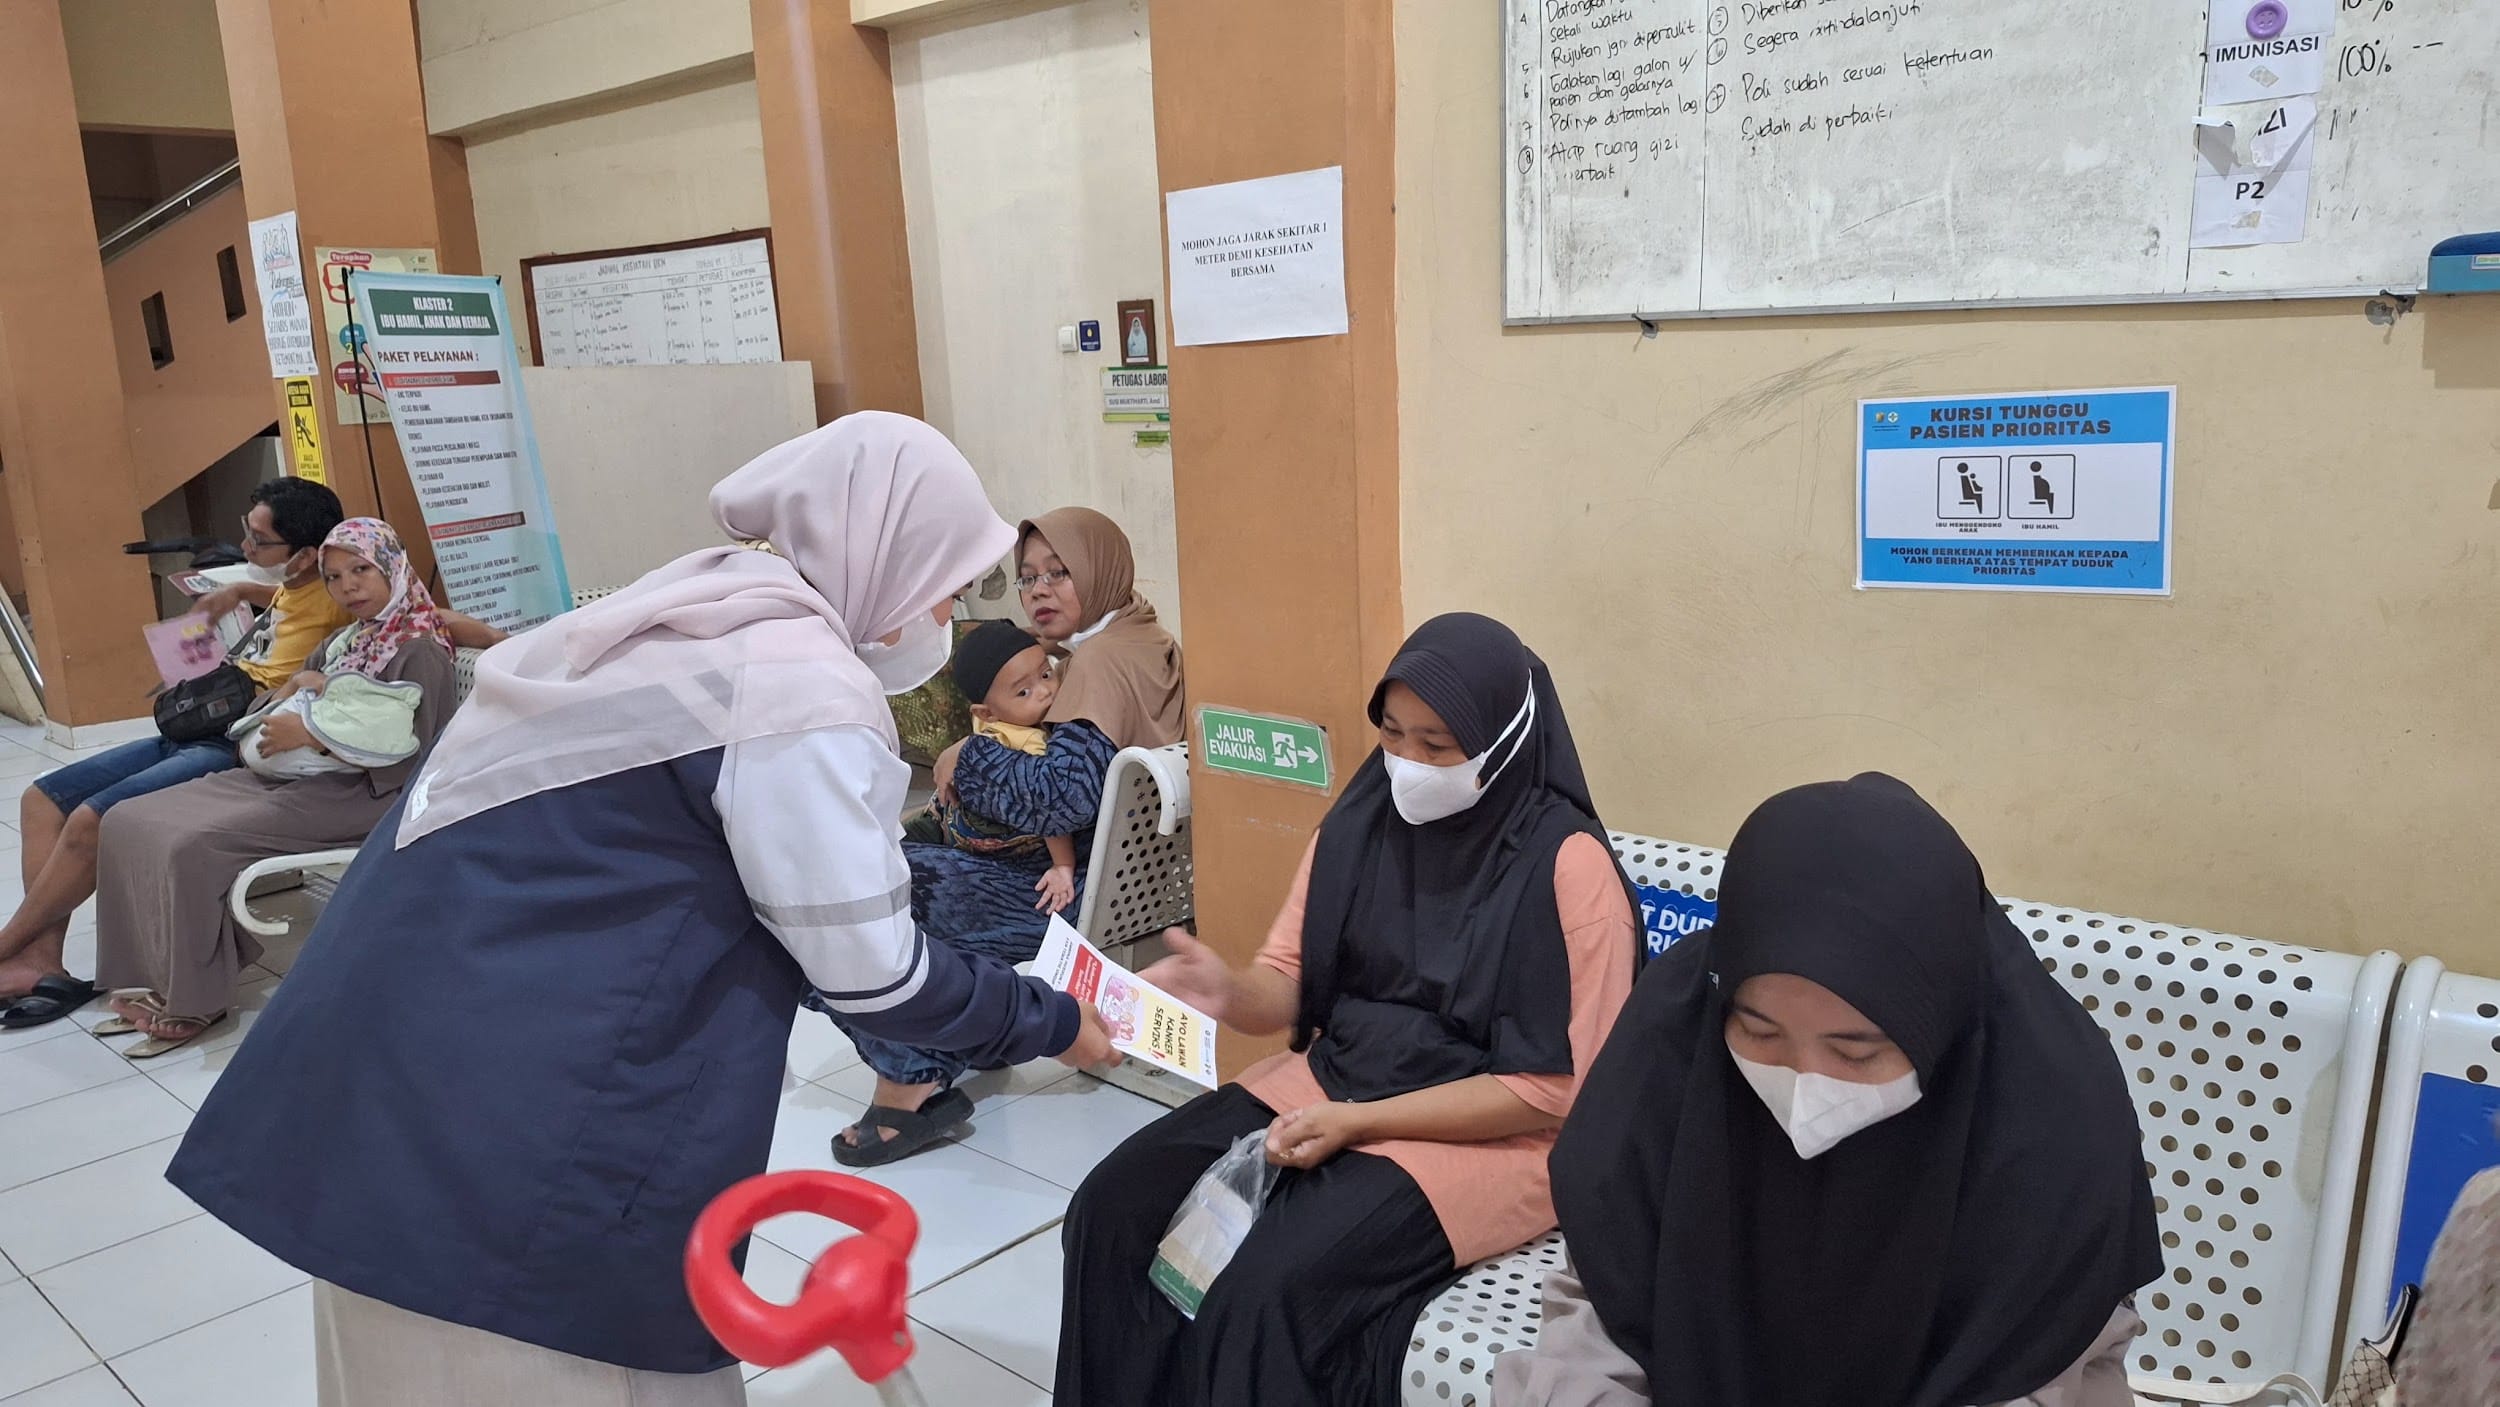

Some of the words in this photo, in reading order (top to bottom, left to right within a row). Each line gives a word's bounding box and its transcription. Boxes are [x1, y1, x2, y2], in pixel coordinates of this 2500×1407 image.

[1591, 10, 1633, 29] waktu
[1744, 30, 1799, 54] Segera
[2215, 36, 2320, 63] IMUNISASI
[1551, 44, 1601, 69] Rujukan
[1607, 41, 1627, 59] jgn
[1602, 69, 1626, 87] lagi
[1633, 59, 1670, 79] galon
[1784, 71, 1829, 95] sudah
[1843, 63, 1887, 83] sesuai
[1550, 93, 1581, 112] pasien
[1588, 85, 1614, 102] dan
[1620, 79, 1674, 101] gelasnya
[1604, 102, 1670, 125] ditambah
[1741, 115, 1792, 141] Sudah
[1799, 114, 1816, 132] di
[1549, 141, 1584, 164] Atap
[1595, 139, 1638, 162] ruang
[1650, 135, 1678, 160] gizi
[2236, 181, 2265, 200] P2
[1182, 237, 1215, 252] MOHON
[1216, 234, 1241, 247] JAGA
[1243, 229, 1275, 243] JARAK
[1277, 223, 1320, 238] SEKITAR
[1195, 250, 1226, 266] METER
[1228, 249, 1252, 262] DEMI
[1255, 241, 1314, 259] KESEHATAN
[1231, 263, 1275, 278] BERSAMA
[413, 297, 447, 311] KLASTER
[447, 299, 454, 311] 2
[380, 314, 396, 329] IBU
[424, 315, 446, 329] ANAK
[446, 315, 462, 329] DAN
[463, 315, 491, 329] REMAJA
[378, 351, 410, 363] PAKET
[414, 352, 473, 363] PELAYANAN
[1112, 374, 1143, 387] PETUGAS
[1931, 406, 1992, 422] KURSI
[1999, 403, 2089, 420] TUNGGU
[1910, 423, 1985, 439] PASIEN
[1992, 420, 2111, 438] PRIORITAS
[1891, 547, 1929, 557] MOHON
[1931, 547, 1994, 558] BERKENAN
[1996, 548, 2076, 559] MEMBERIKAN
[2078, 549, 2129, 559] KEPADA
[1903, 556, 1934, 566] YANG
[1935, 556, 1983, 566] BERHAK
[1985, 557, 2018, 567] ATAS
[2019, 558, 2070, 567] TEMPAT
[2072, 558, 2114, 568] DUDUK
[1973, 566, 2036, 576] PRIORITAS
[1216, 723, 1256, 744] JALUR
[1209, 739, 1267, 763] EVAKUASI
[1647, 930, 1680, 954] RI
[1151, 1006, 1164, 1049] SERVIKS
[1164, 1016, 1175, 1056] KANKER
[1179, 1012, 1188, 1036] AYO
[1178, 1036, 1187, 1068] LAWAN
